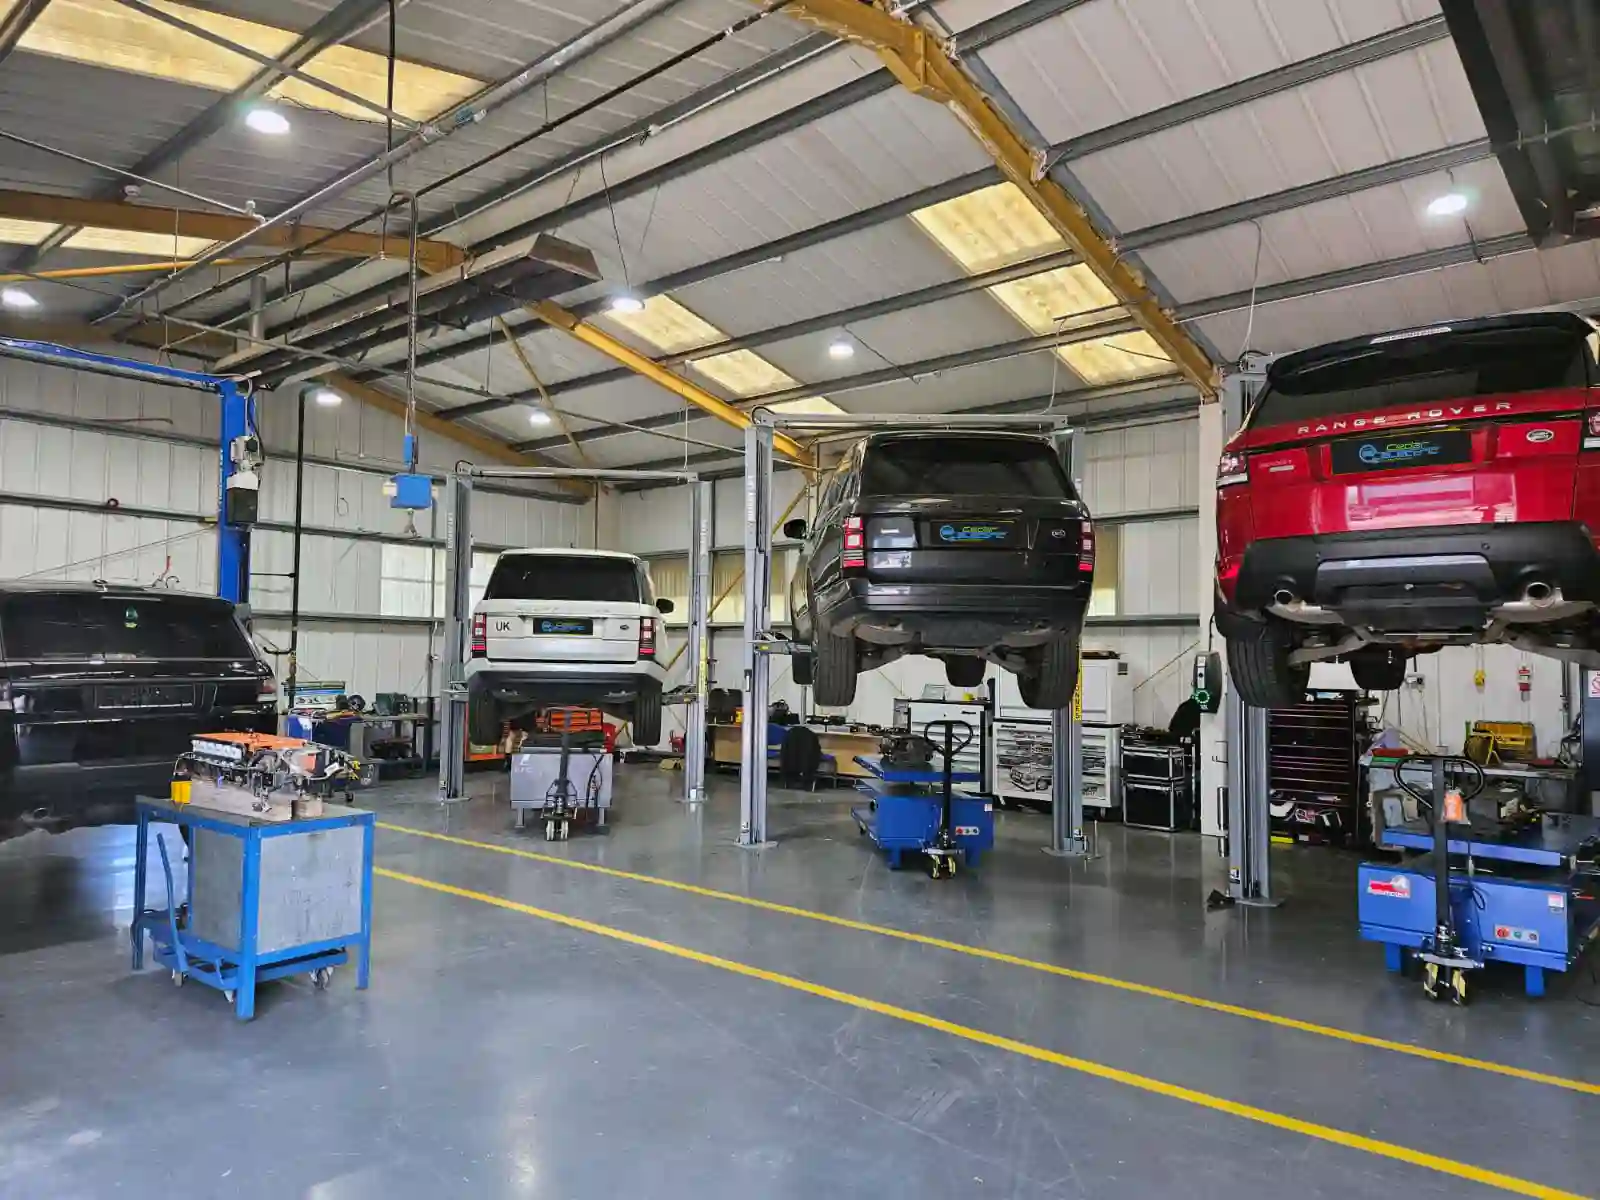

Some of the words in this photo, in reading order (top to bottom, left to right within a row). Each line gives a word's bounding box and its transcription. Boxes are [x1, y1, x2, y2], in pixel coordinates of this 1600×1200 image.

[1297, 416, 1386, 434] RANGE
[1408, 402, 1511, 420] ROVER
[496, 620, 511, 632] UK
